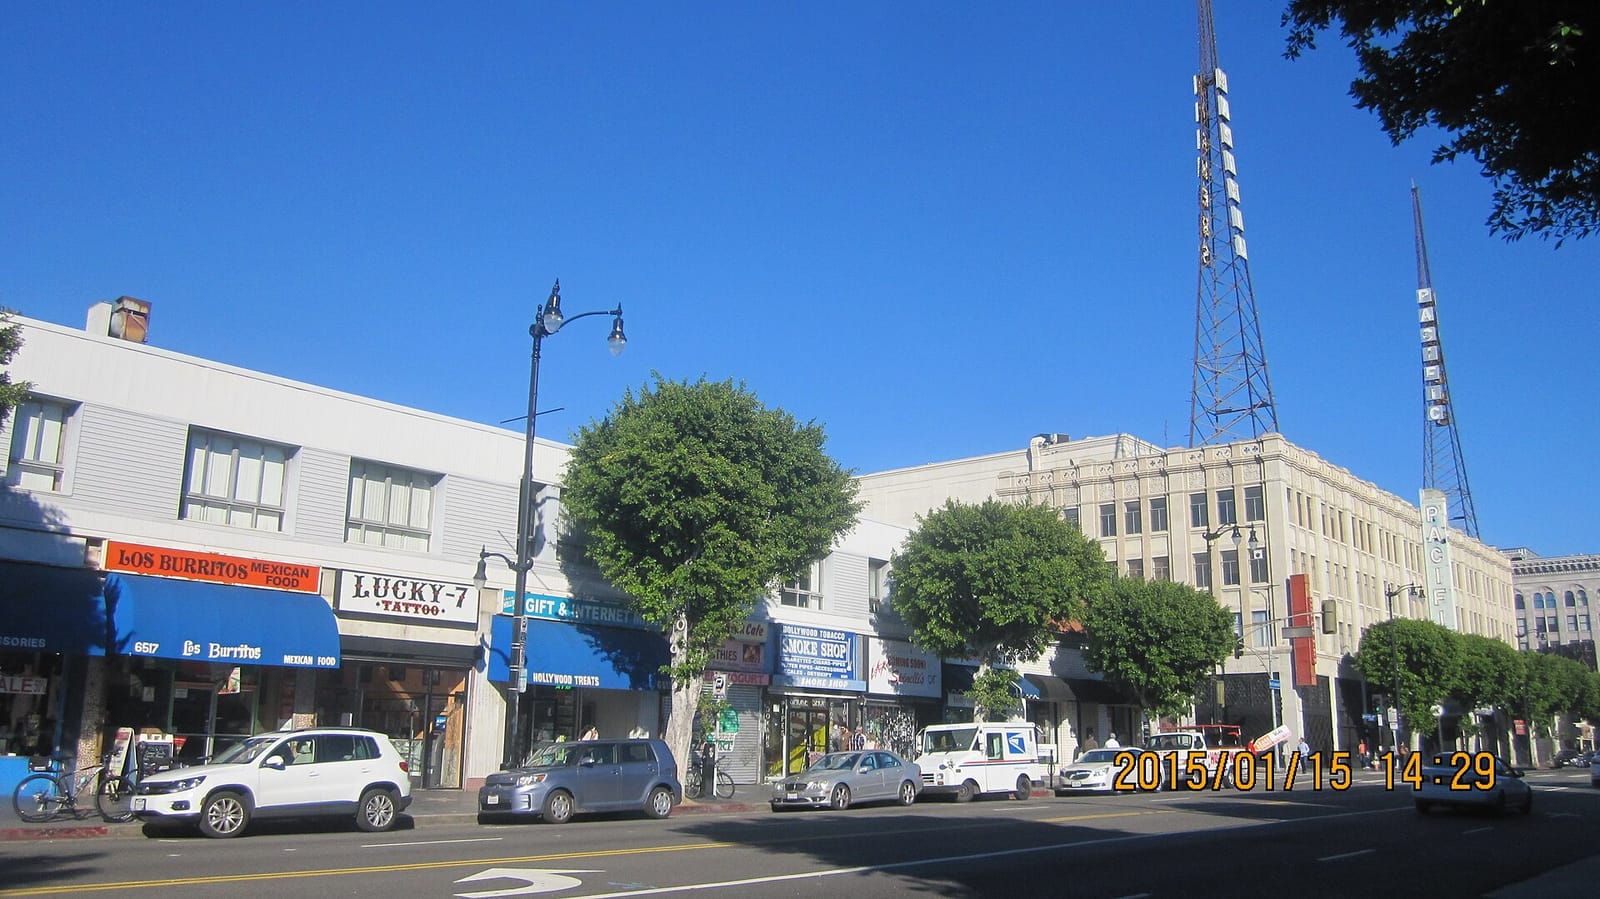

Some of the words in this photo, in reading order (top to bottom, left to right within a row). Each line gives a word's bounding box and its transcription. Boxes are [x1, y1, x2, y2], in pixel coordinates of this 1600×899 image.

[118, 549, 154, 568] LOS
[160, 554, 248, 580] BURRITOS
[251, 562, 309, 578] MEXICAN
[265, 575, 299, 588] FOOD
[352, 574, 468, 609] LUCKY-7
[381, 600, 440, 616] TATTOO
[525, 598, 555, 615] GIFT
[557, 602, 567, 616] &
[571, 603, 630, 624] INTERNET
[782, 625, 818, 637] HOLLYWOOD
[819, 630, 846, 641] TOBACCO
[134, 641, 159, 654] 6517
[182, 639, 201, 657] Los
[208, 642, 261, 660] Burritos
[283, 655, 313, 665] MEXICAN
[317, 655, 336, 666] FOOD
[782, 638, 818, 656] SMOKE
[820, 642, 846, 659] SHOP
[533, 672, 572, 685] HOLLYWOOD
[574, 675, 600, 687] TREATS
